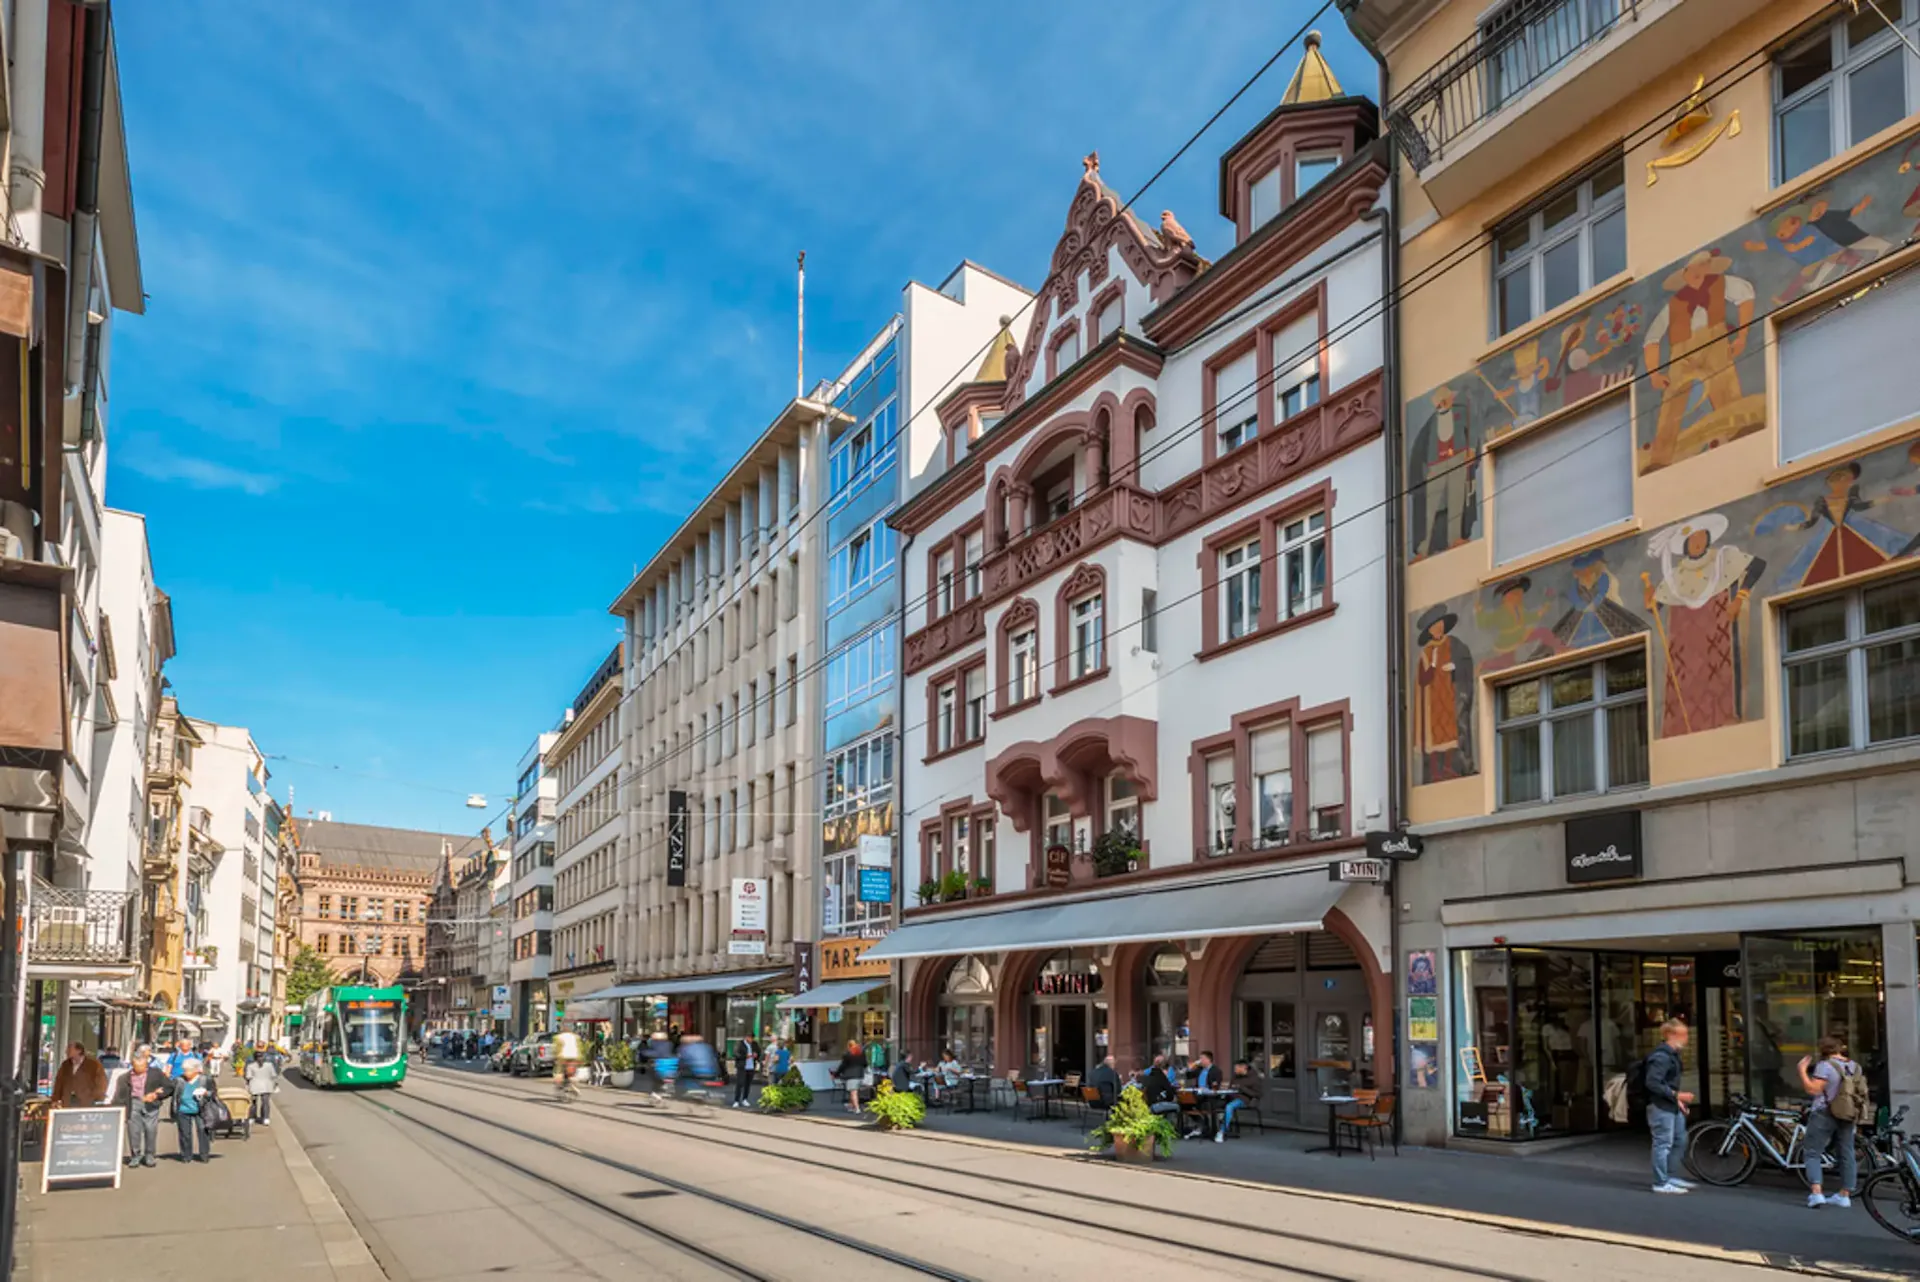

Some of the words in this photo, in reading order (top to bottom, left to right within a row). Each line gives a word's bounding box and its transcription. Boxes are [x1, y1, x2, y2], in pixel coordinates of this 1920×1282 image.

[670, 835, 684, 870] PKZ
[1342, 862, 1377, 877] LATINI
[823, 946, 888, 969] TARZ
[1035, 972, 1089, 995] LATINI
